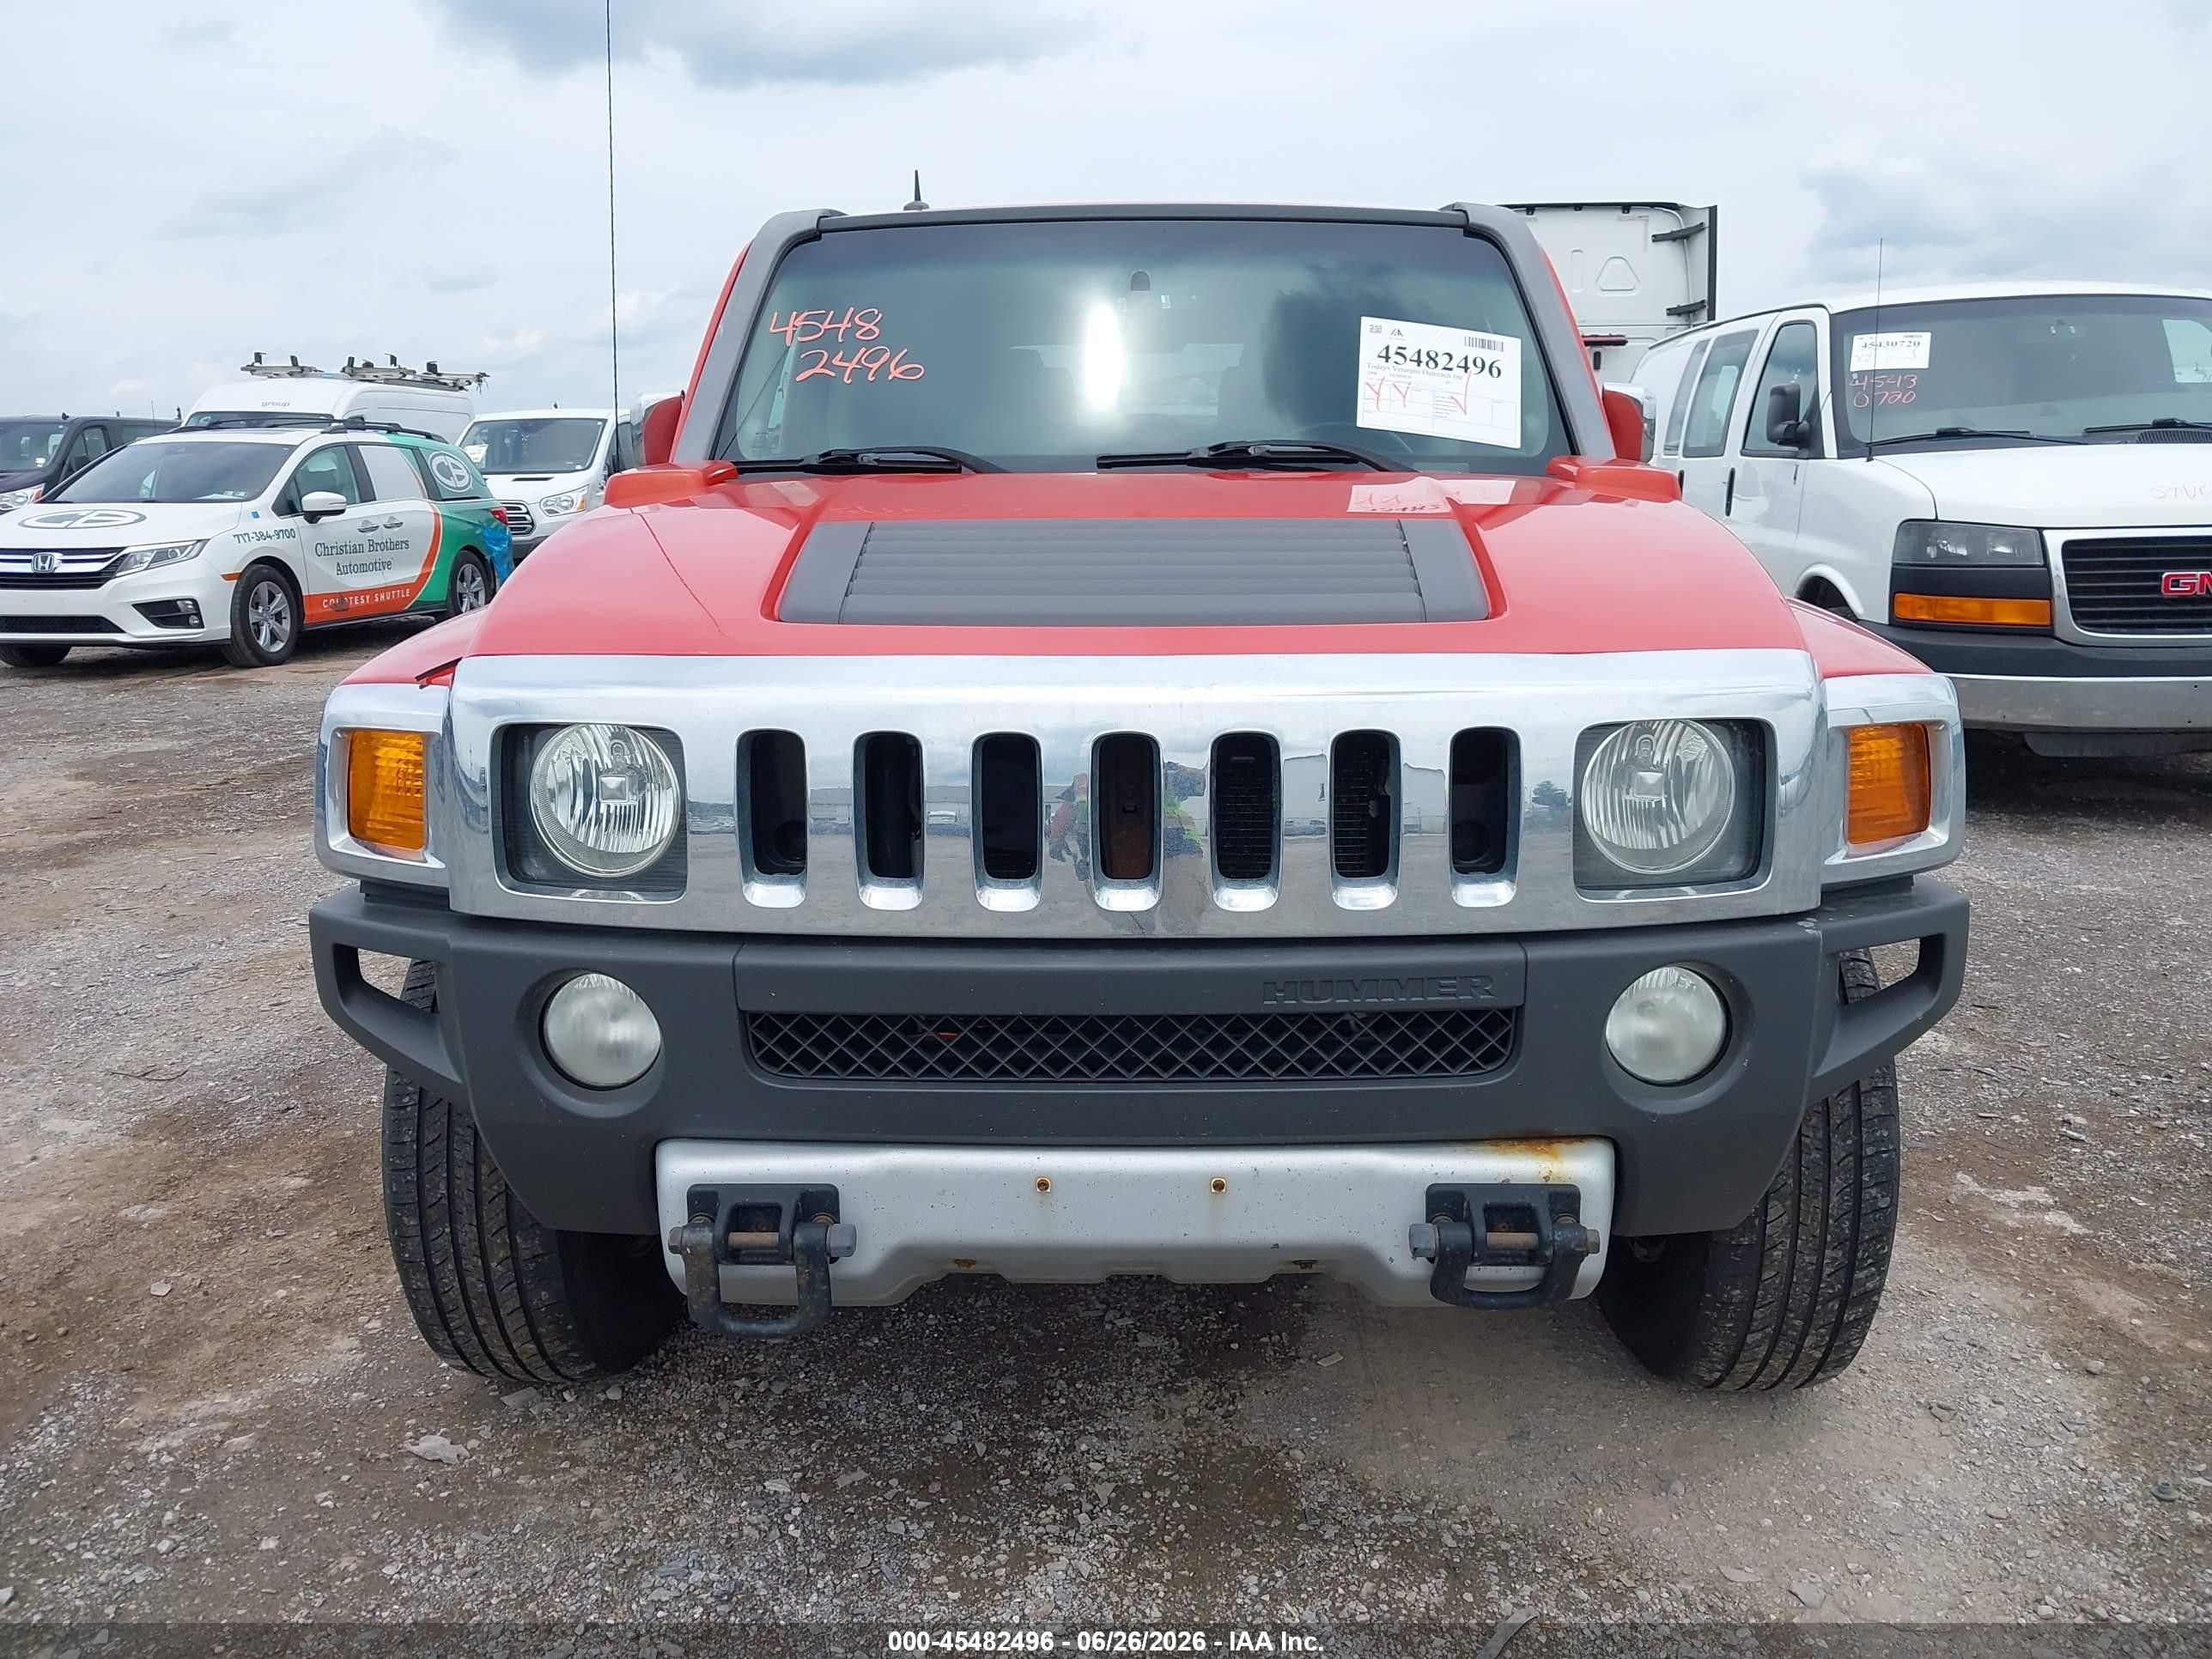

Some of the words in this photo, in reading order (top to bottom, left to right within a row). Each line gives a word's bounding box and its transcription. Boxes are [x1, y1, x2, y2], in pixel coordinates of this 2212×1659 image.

[769, 307, 883, 346] 4548
[795, 345, 925, 385] 2496
[1377, 344, 1502, 379] 45482496
[1850, 374, 1917, 391] 4543
[1853, 391, 1916, 408] 0720
[234, 528, 296, 544] 717-384-9700
[315, 541, 365, 557] Christian
[368, 538, 410, 552] Brothers
[336, 559, 392, 576] Automotive
[374, 588, 410, 602] SHUTTLE
[1263, 975, 1495, 1005] HUMMER
